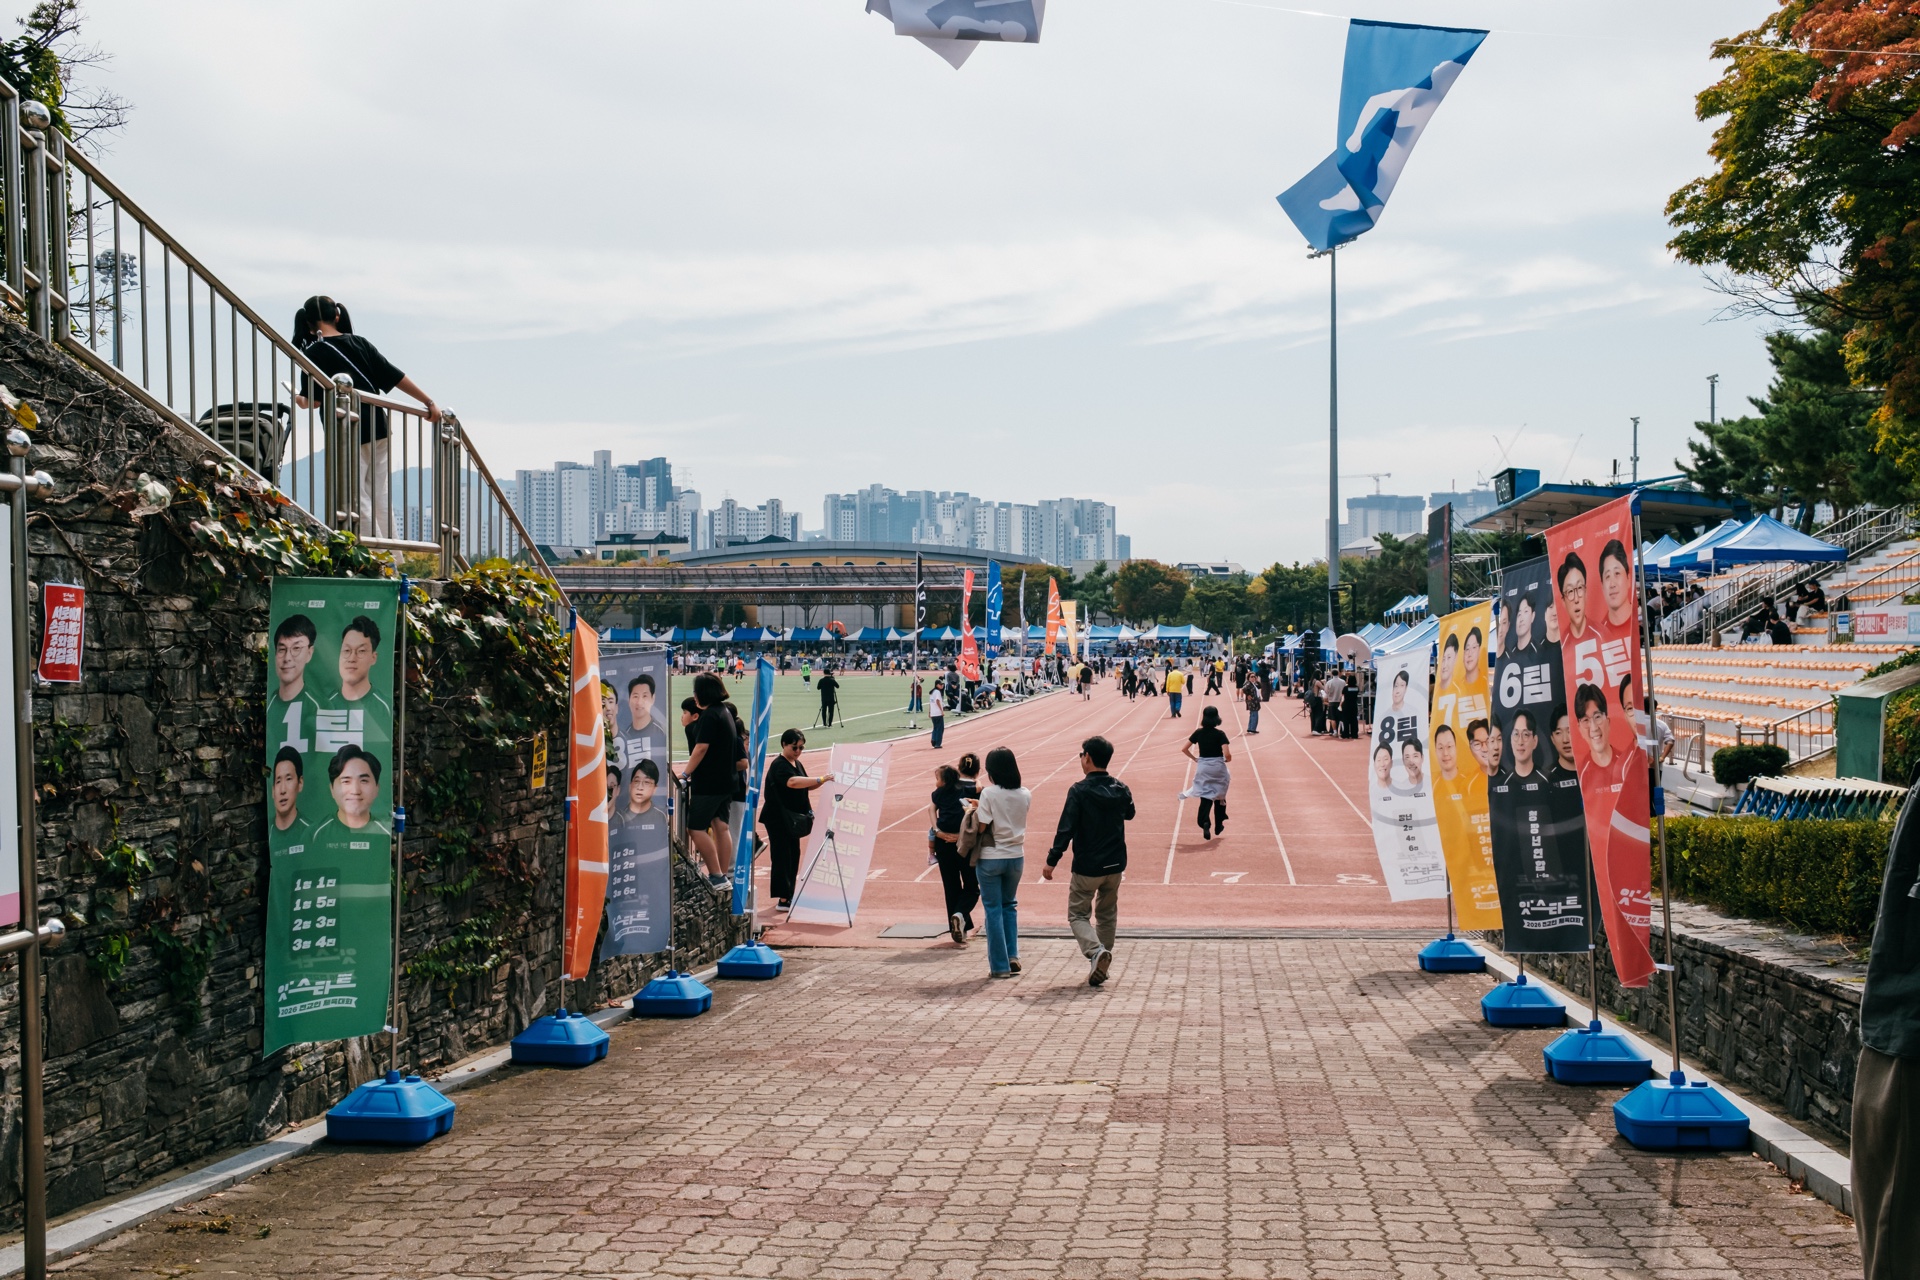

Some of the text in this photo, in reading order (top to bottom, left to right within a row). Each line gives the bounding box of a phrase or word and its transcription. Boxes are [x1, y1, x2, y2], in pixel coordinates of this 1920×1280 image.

[1574, 636, 1632, 690] 5팀
[1499, 662, 1552, 708] 6팀
[280, 701, 364, 752] 1팀
[1438, 693, 1488, 730] 7팀
[1379, 716, 1418, 746] 8팀
[607, 736, 652, 771] 3팀
[1399, 814, 1412, 822] 장년
[1528, 810, 1546, 872] 청장년연합
[1210, 871, 1250, 884] 7
[1336, 873, 1378, 886] 8
[1558, 917, 1581, 926] 체육대회
[299, 1001, 322, 1011] 전교인
[323, 998, 353, 1006] 체육대회
